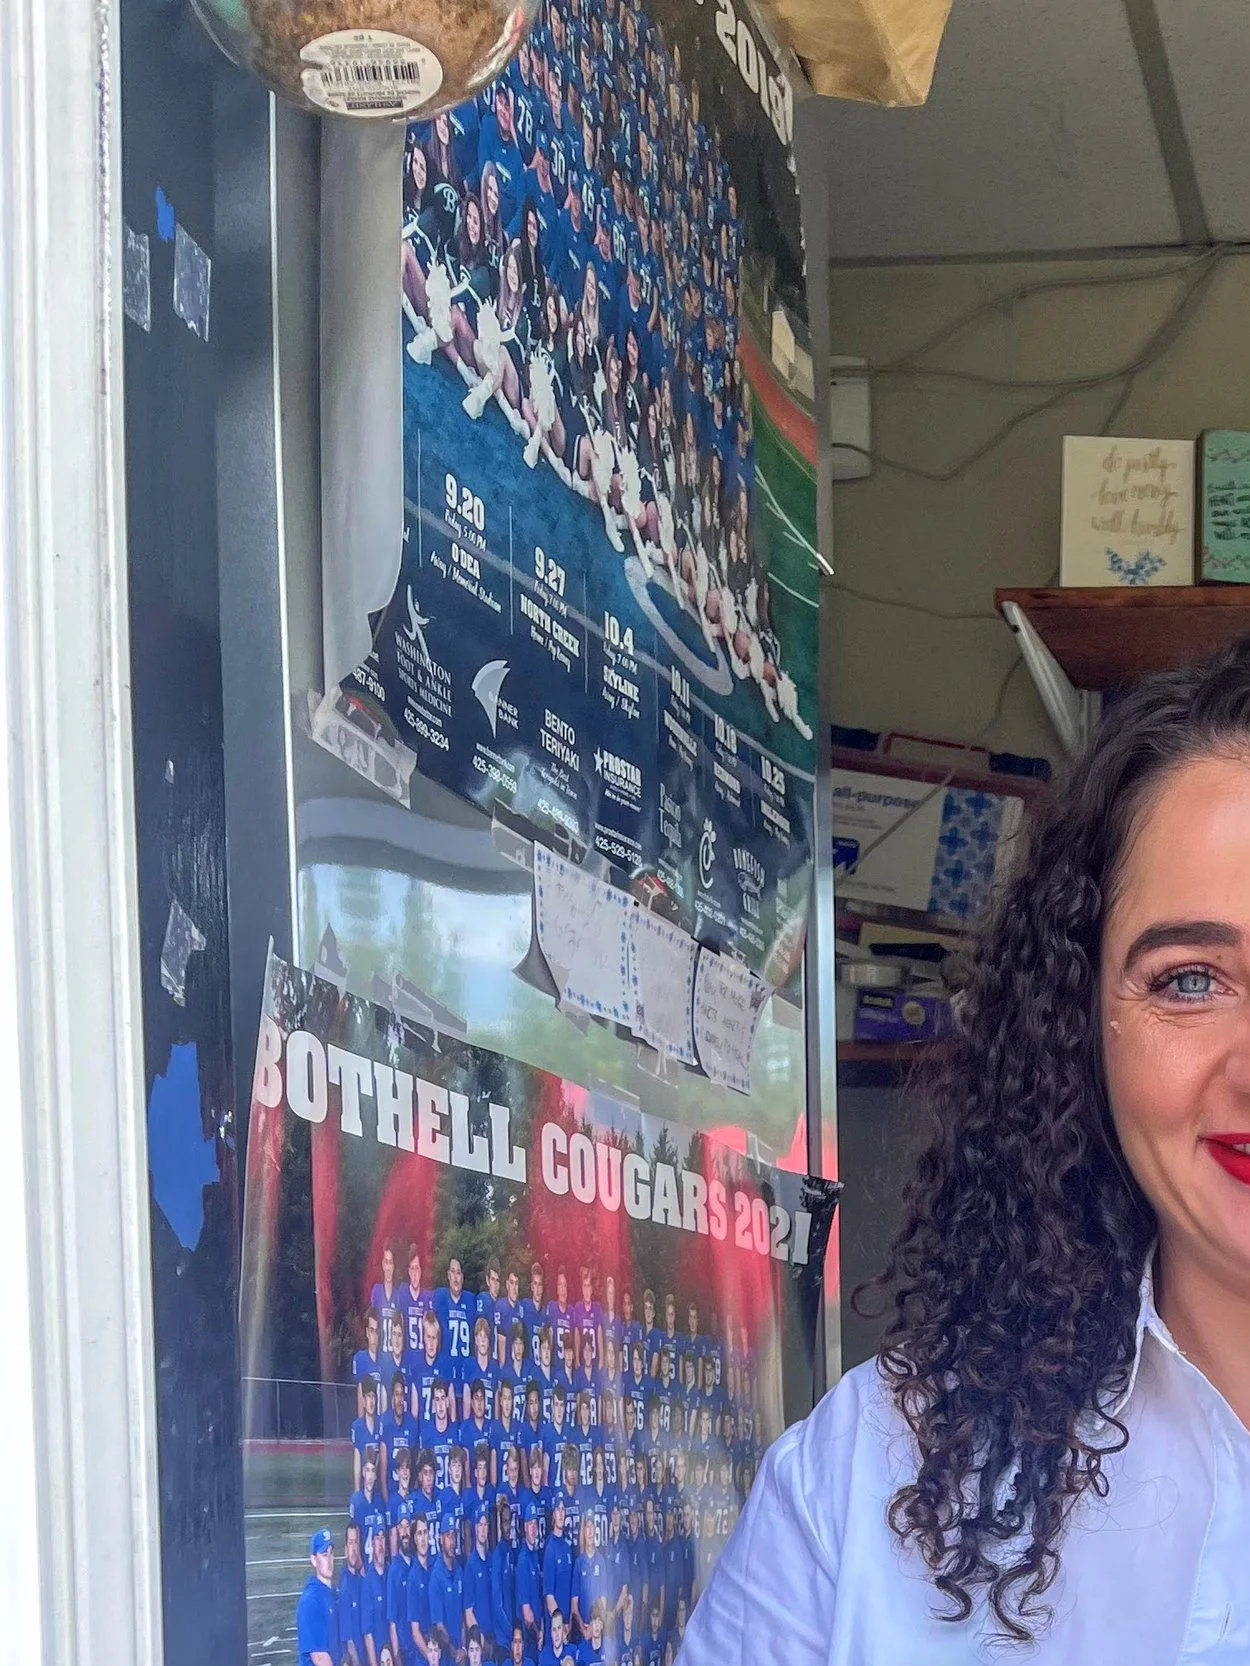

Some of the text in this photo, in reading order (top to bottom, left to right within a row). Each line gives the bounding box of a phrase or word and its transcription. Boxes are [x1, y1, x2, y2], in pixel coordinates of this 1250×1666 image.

[444, 473, 485, 532] 9.20
[533, 546, 567, 597] 9.27
[520, 593, 552, 634] NORTH
[603, 610, 635, 657] 10.4
[394, 630, 452, 686] WASHINGTON
[497, 708, 520, 730] BANK
[544, 708, 577, 746] BENTO
[539, 727, 580, 773] TERIYAKI
[602, 749, 642, 787] PROSTAR
[602, 768, 642, 799] INSURANCE
[256, 1013, 527, 1184] BOTHELL
[540, 1120, 812, 1266] COUGARS 2021
